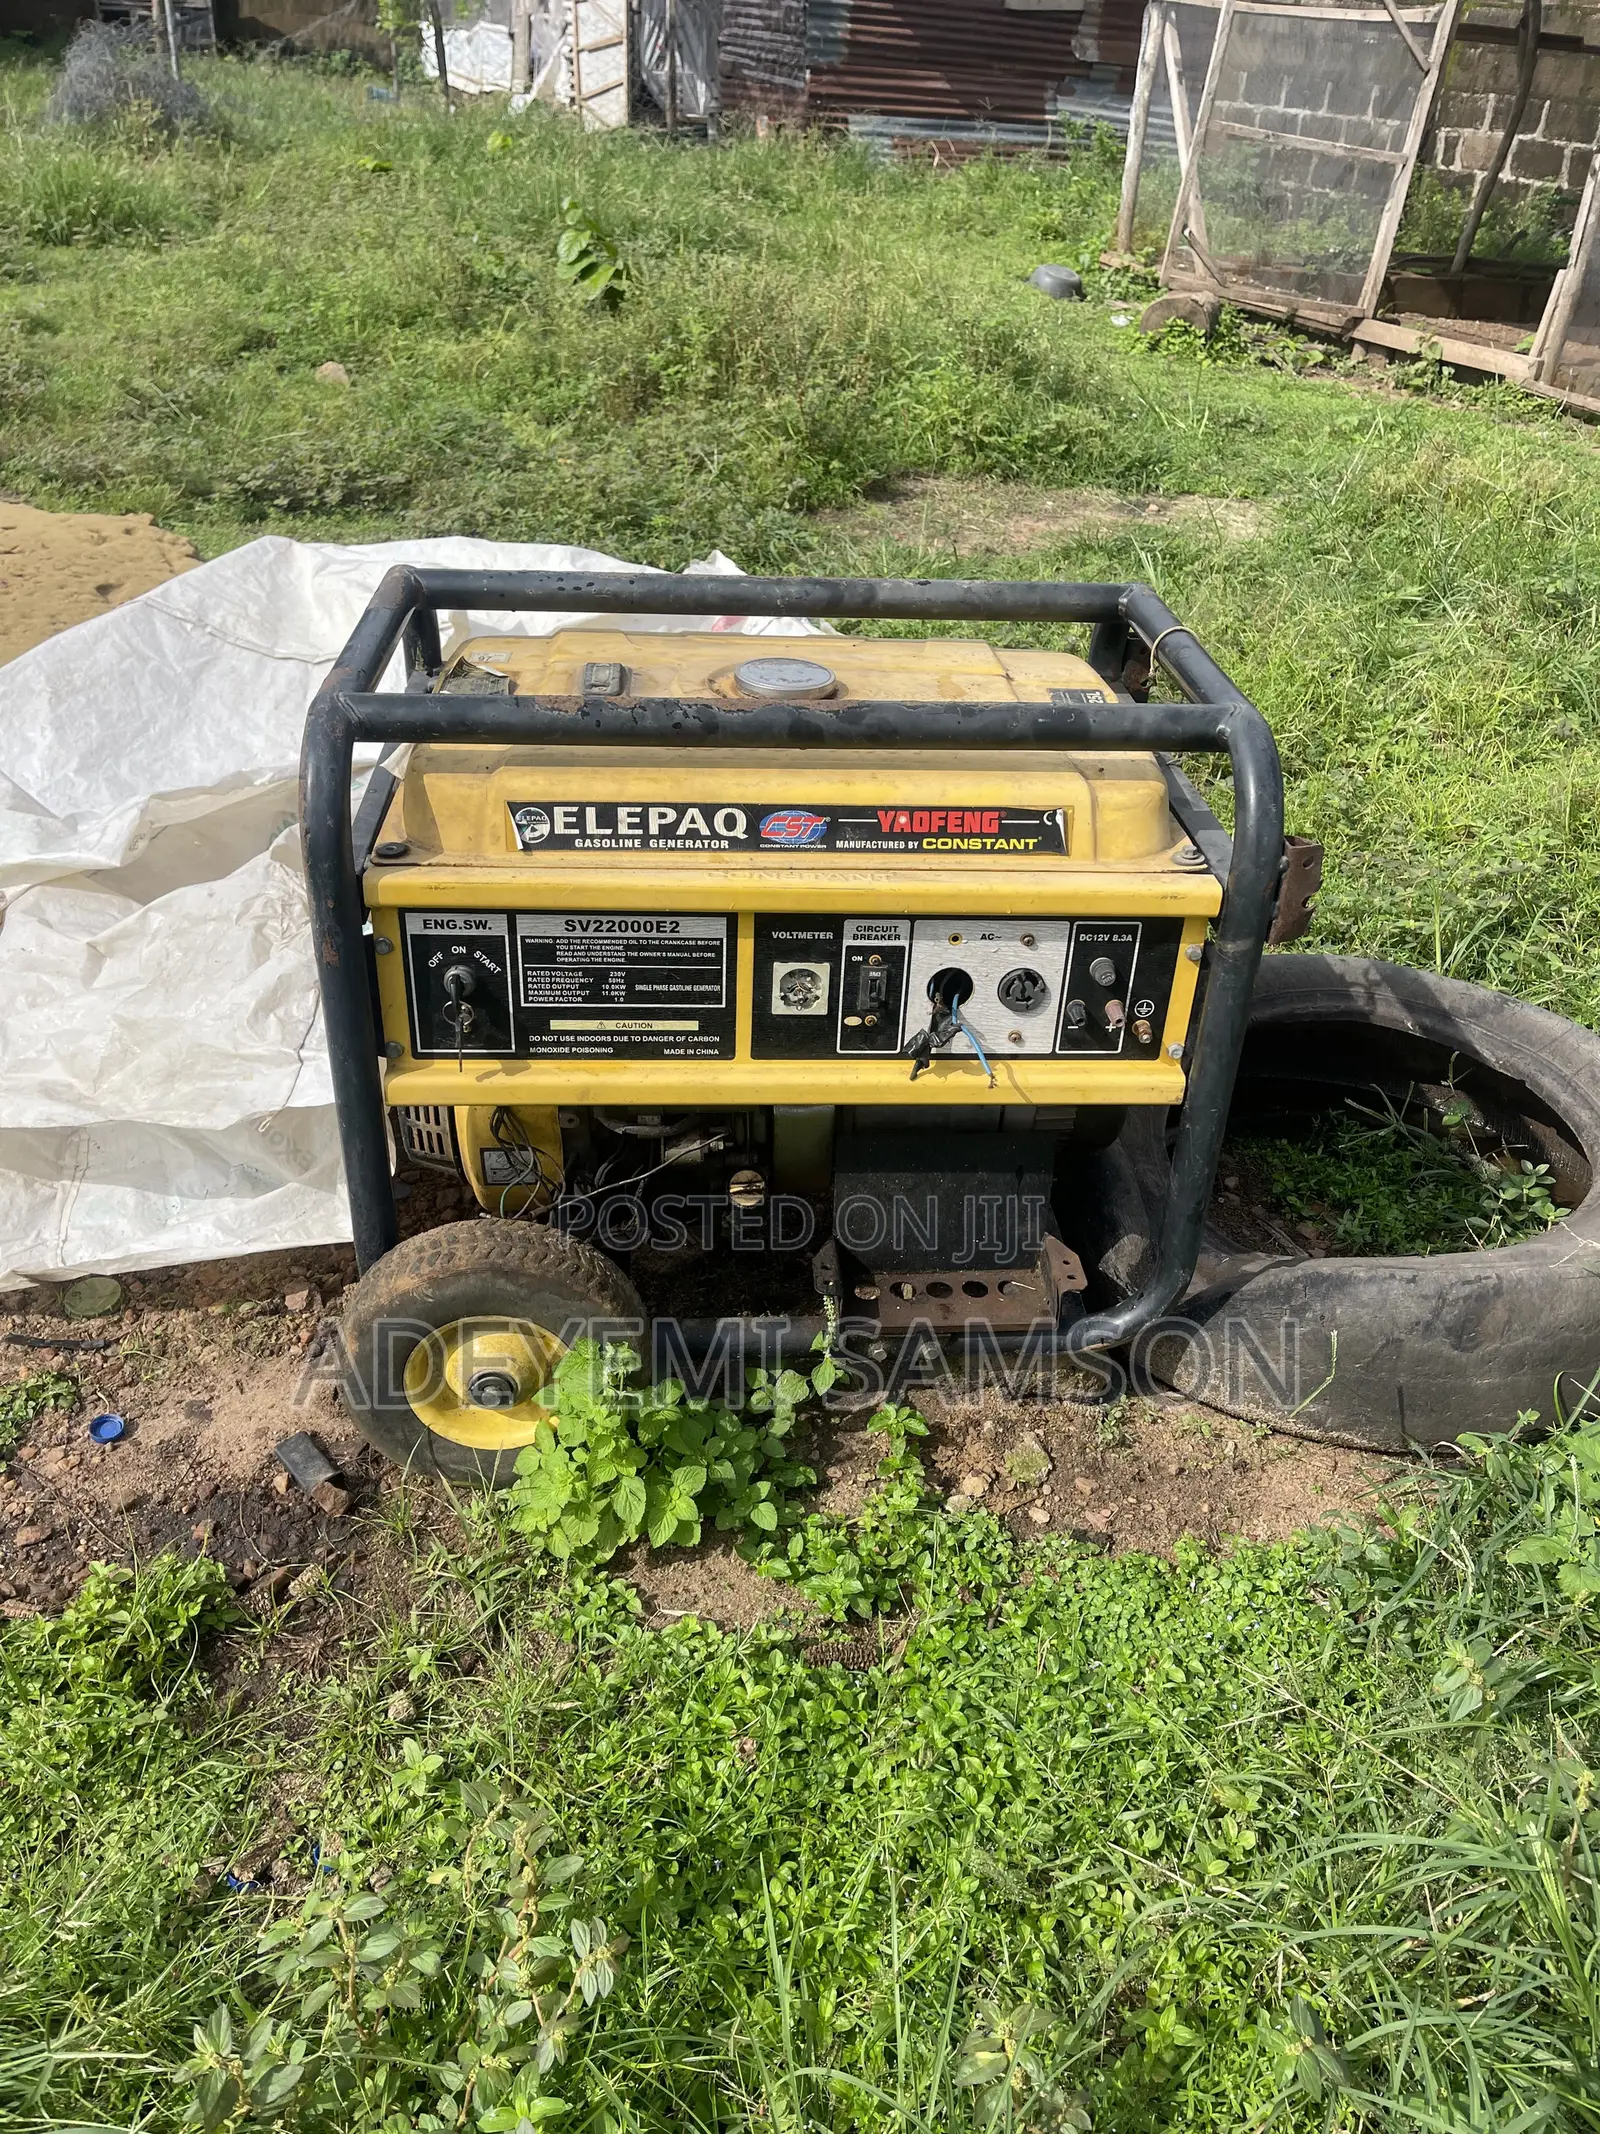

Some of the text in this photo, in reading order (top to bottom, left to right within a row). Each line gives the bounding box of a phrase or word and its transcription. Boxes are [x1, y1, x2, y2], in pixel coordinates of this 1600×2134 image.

[553, 806, 749, 839] ELEPAQ
[761, 816, 827, 838] CST
[877, 810, 1000, 833] YAOFENG
[574, 838, 730, 849] GASOLINE GENERATOR
[836, 837, 1038, 850] MANUFACTURED BY CONSTANT
[422, 919, 493, 930] ENG.SW.
[564, 919, 680, 934] SV22000E2
[772, 931, 834, 940] VOLTMETER
[1079, 934, 1133, 942] DC12V 8.3A
[451, 946, 467, 954] ON
[428, 951, 444, 968] OFF
[473, 950, 502, 975] START
